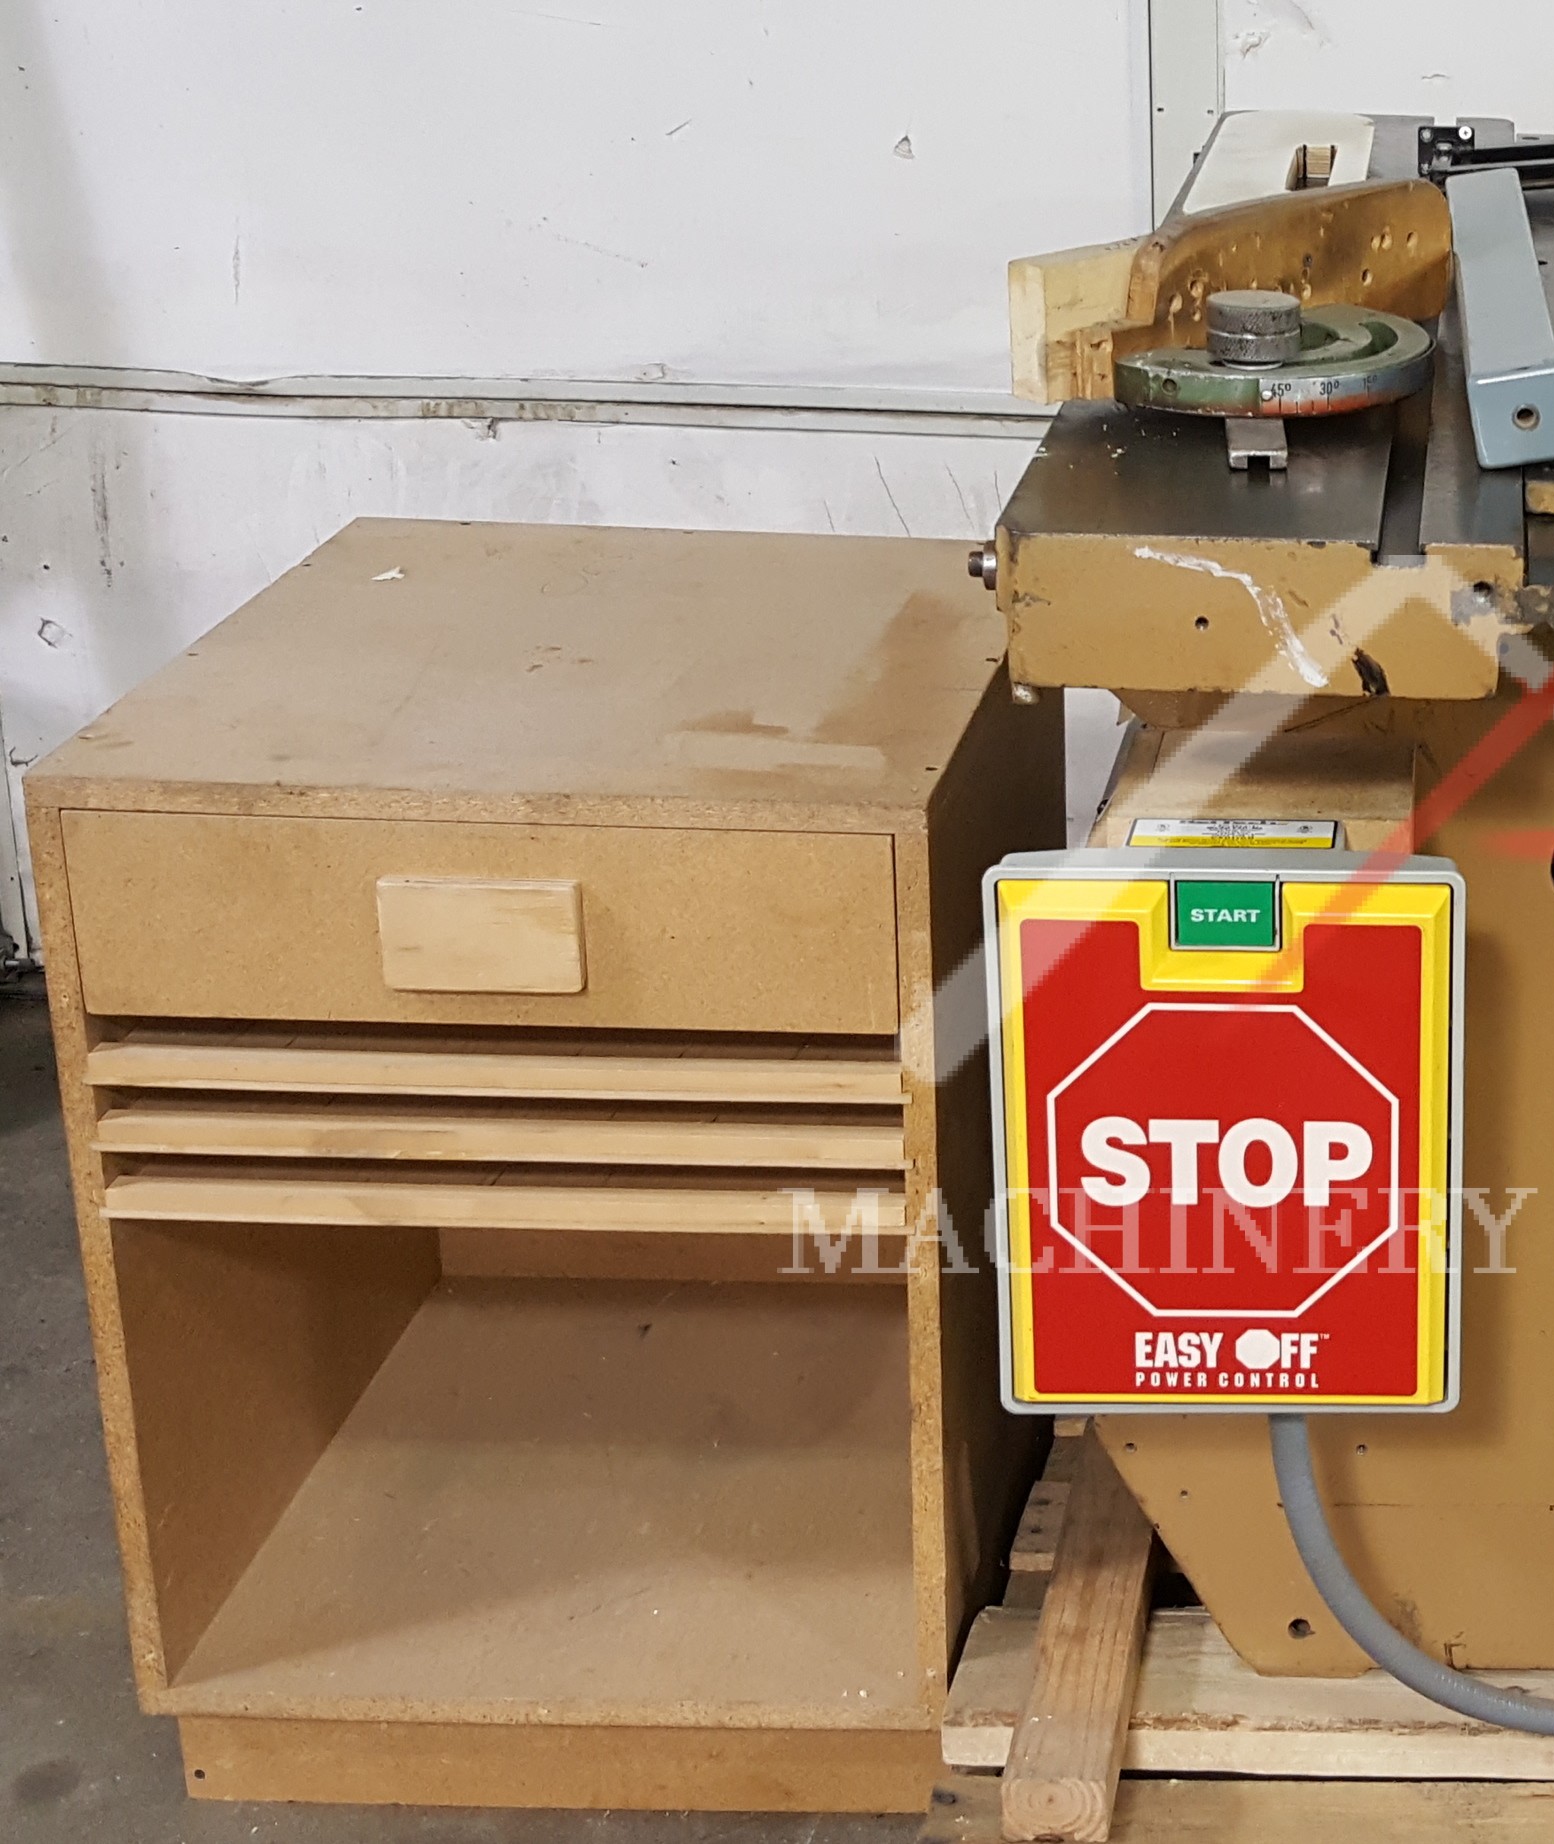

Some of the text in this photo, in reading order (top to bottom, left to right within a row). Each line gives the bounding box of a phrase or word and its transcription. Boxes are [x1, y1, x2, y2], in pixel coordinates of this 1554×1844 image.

[1190, 908, 1260, 923] START
[1080, 1116, 1373, 1208] STOP
[1135, 1331, 1224, 1368] EASY
[1135, 1372, 1319, 1388] POWER CONTROL
